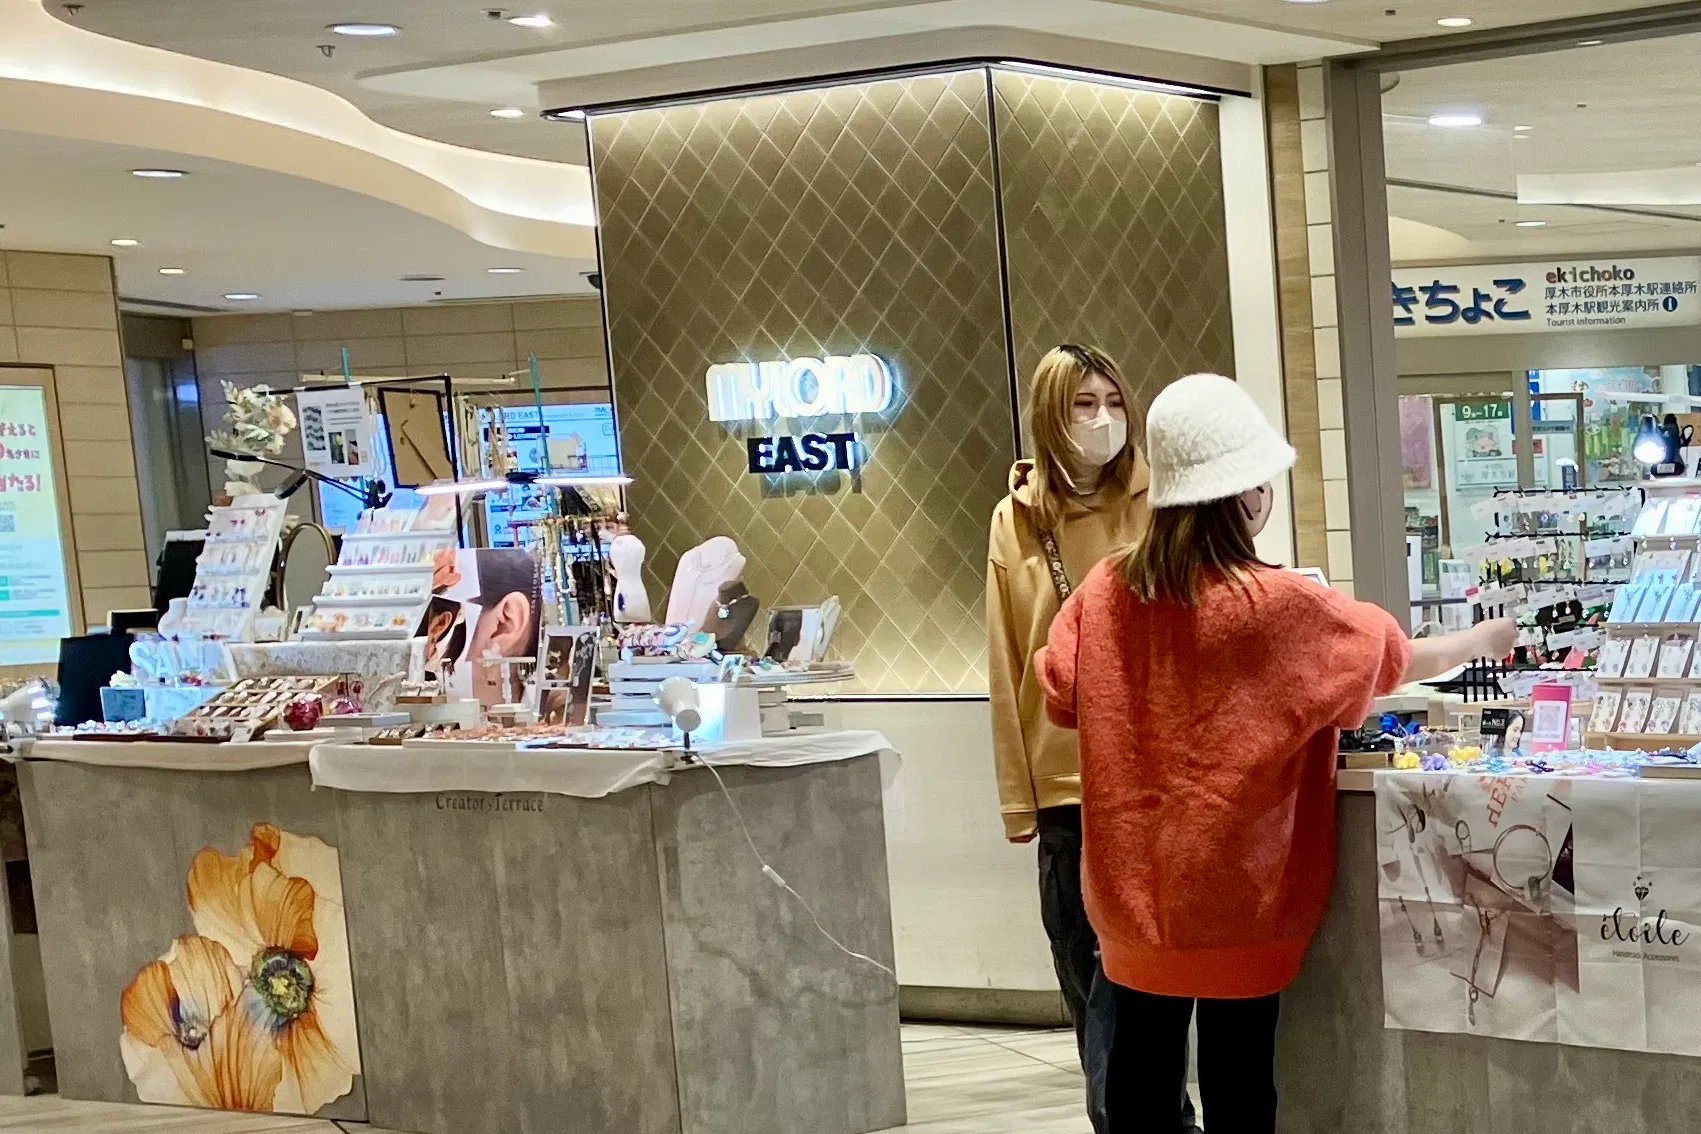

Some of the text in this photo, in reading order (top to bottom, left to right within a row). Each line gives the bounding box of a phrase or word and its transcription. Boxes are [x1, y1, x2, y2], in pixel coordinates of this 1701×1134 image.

[1546, 265, 1635, 283] ekichoko
[1546, 298, 1659, 315] 本厚木駅観光案内所
[1547, 317, 1575, 327] Tourist
[747, 432, 858, 474] EAST
